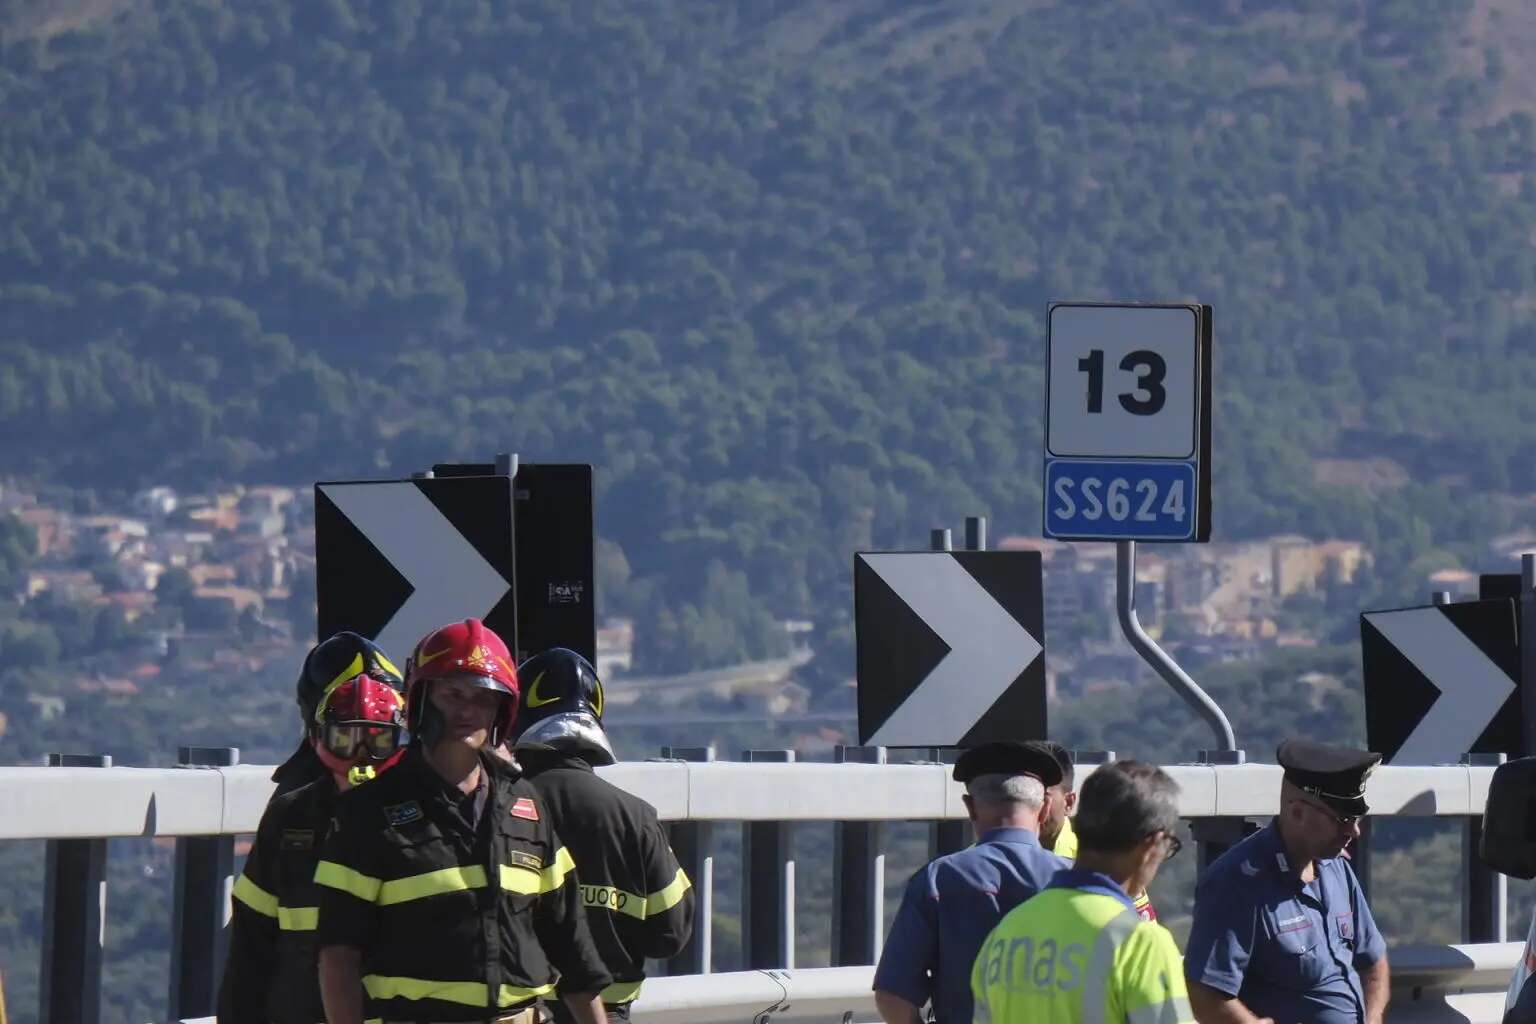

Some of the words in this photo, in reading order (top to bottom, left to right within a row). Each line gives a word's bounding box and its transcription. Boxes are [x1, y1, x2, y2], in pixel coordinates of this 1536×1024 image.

[1078, 349, 1167, 416] 13
[1054, 476, 1187, 523] SS624
[988, 936, 1088, 992] anas
